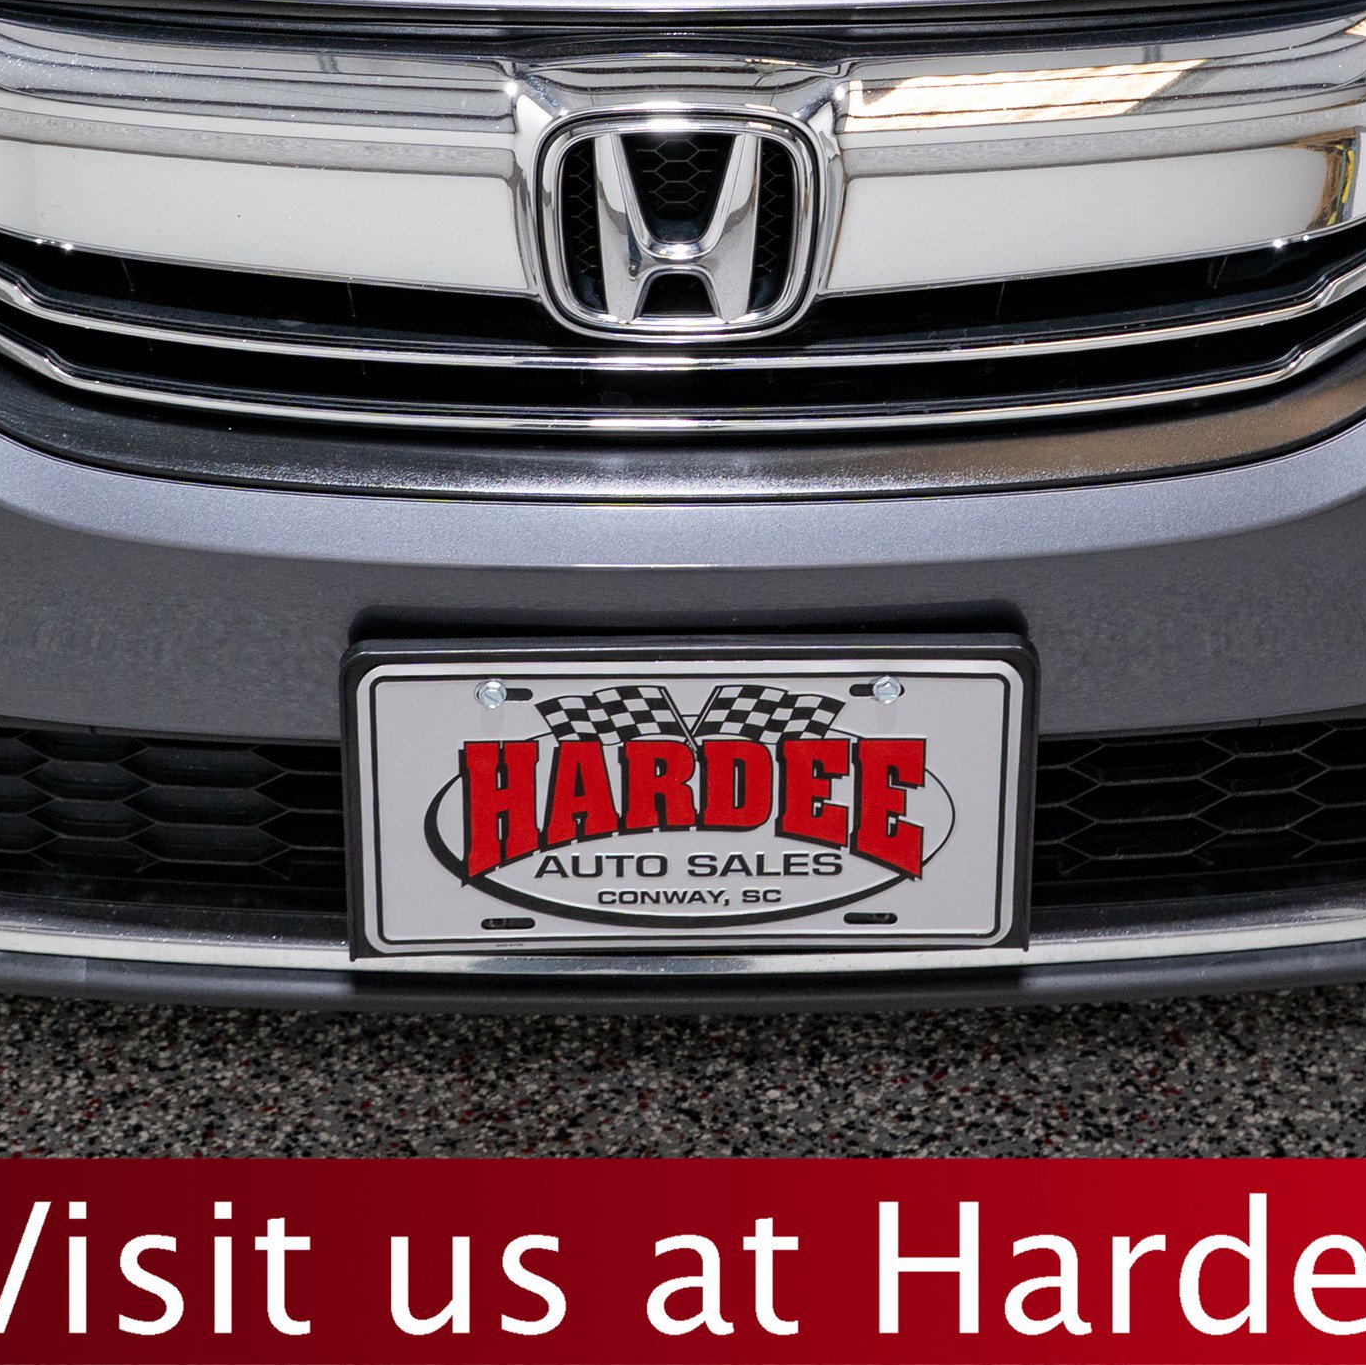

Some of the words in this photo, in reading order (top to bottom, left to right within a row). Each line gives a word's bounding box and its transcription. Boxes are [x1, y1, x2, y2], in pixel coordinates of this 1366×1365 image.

[458, 737, 926, 886] HARDEE
[534, 854, 669, 879] AUTO
[686, 852, 844, 878] SALES
[596, 889, 731, 908] CONWAY,
[742, 888, 783, 904] SC
